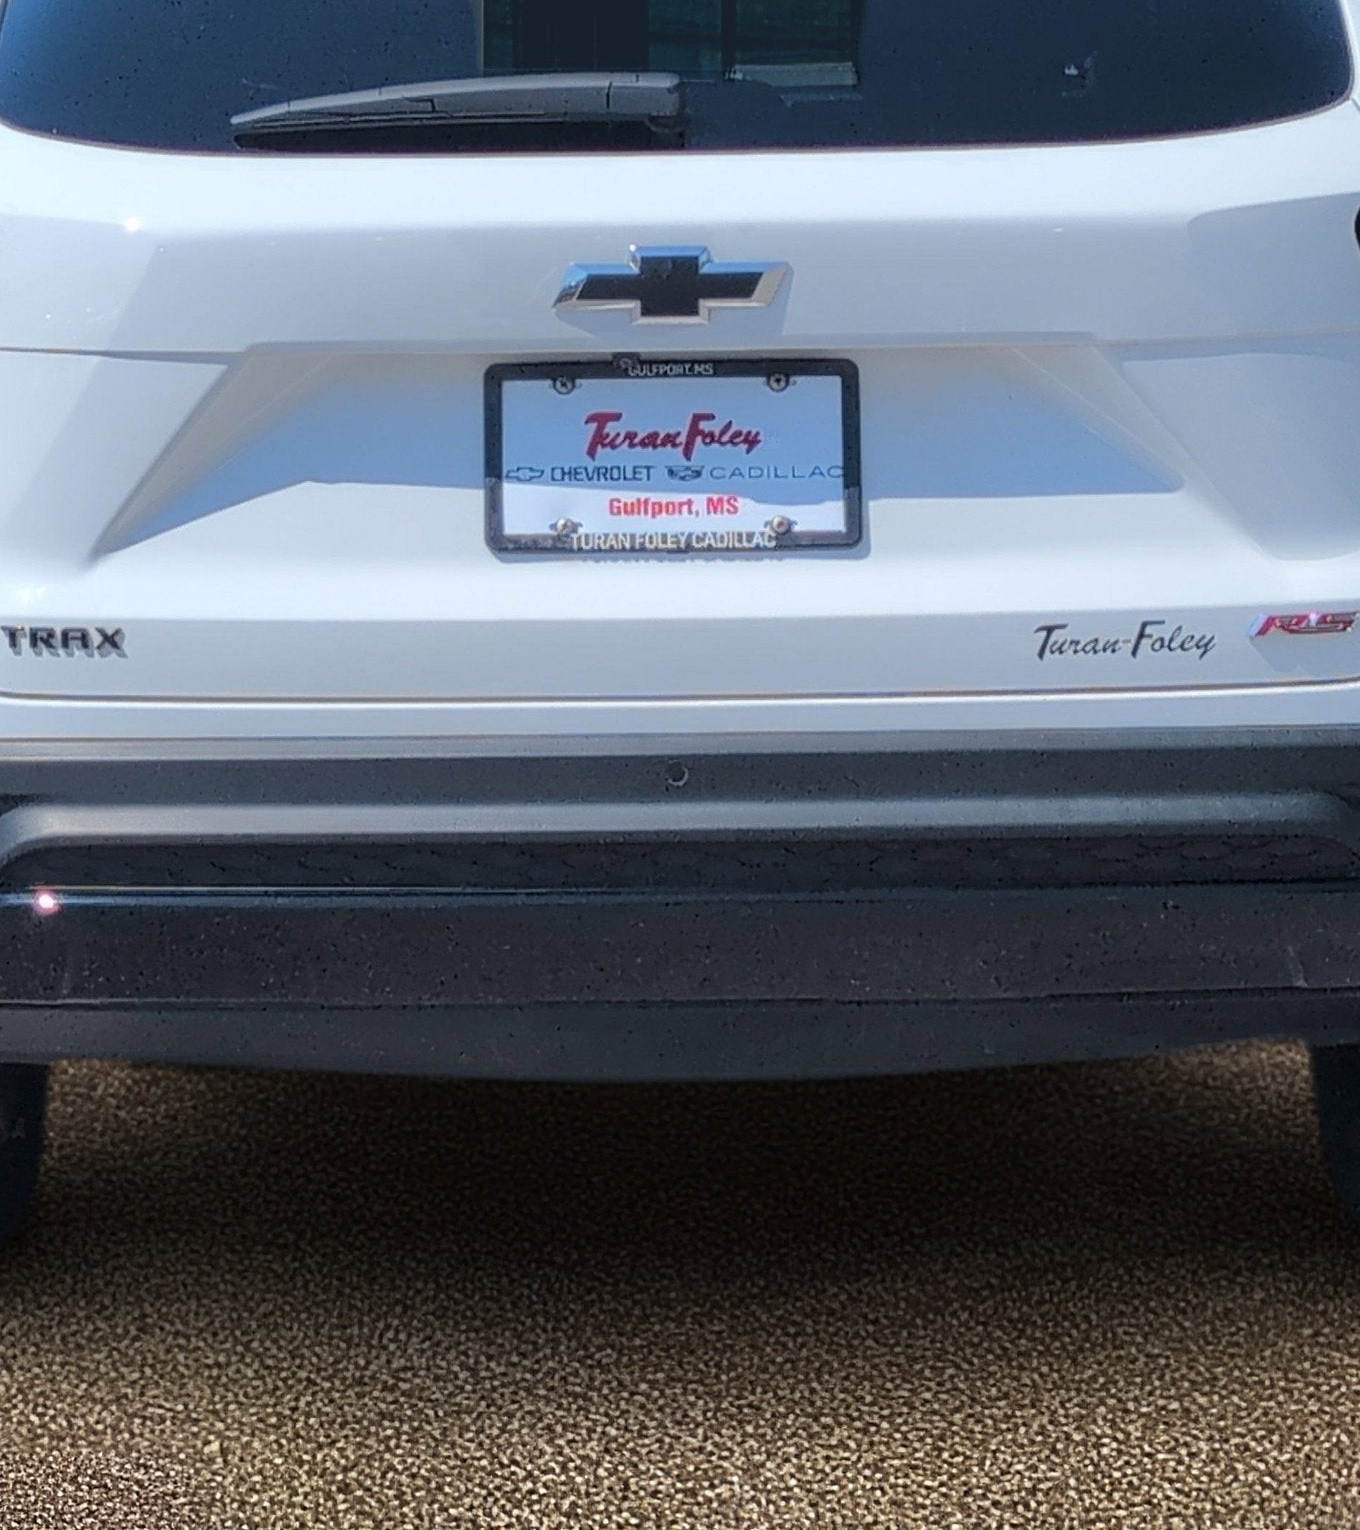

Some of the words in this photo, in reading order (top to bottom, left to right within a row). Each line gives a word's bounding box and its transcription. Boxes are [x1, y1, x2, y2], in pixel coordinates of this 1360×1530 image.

[584, 411, 683, 462] Turan
[682, 412, 762, 462] Foley
[551, 465, 653, 482] CHEVROLET
[709, 465, 845, 480] CADILLAC
[609, 496, 699, 518] Gulfport,
[706, 496, 739, 516] MS
[571, 532, 630, 550] TURAN
[636, 532, 687, 550] FOLEY
[692, 531, 776, 549] CADILLAC
[0, 626, 123, 651] TRAX
[1034, 623, 1121, 661] Turan
[1130, 620, 1216, 661] Foley
